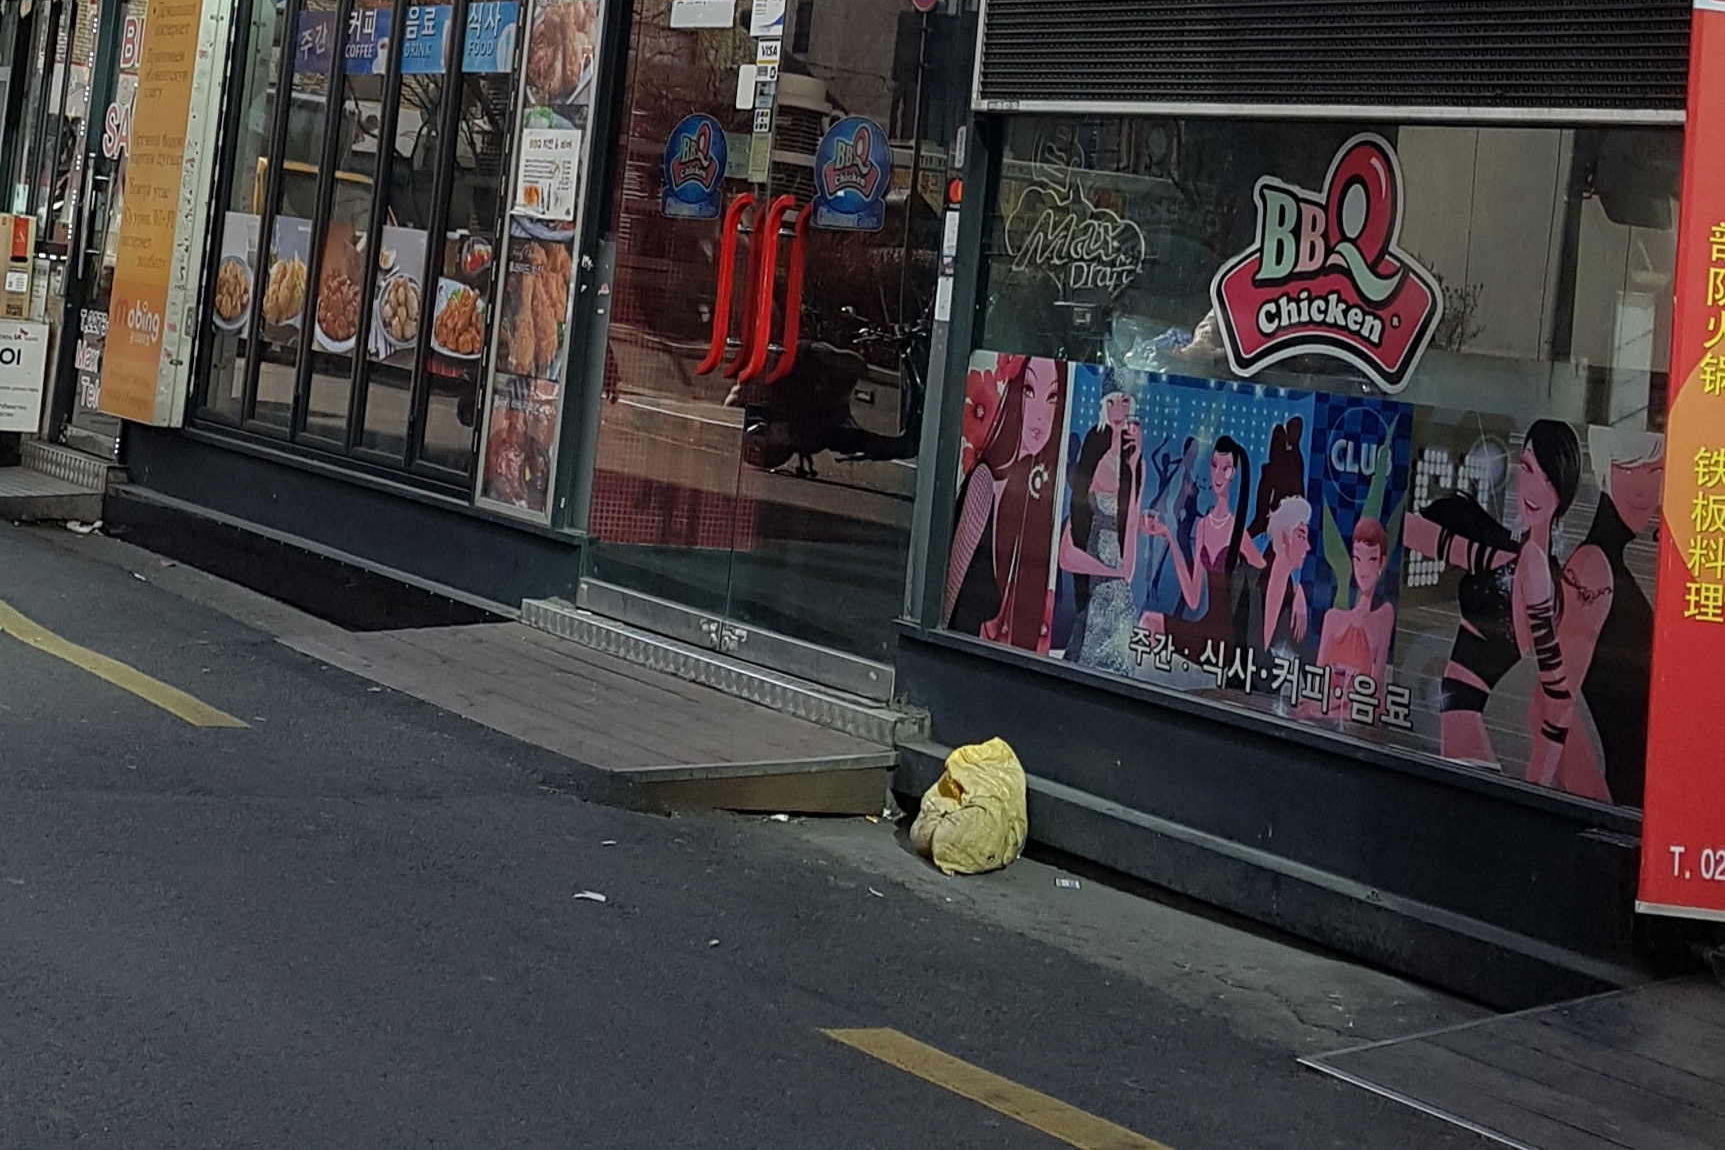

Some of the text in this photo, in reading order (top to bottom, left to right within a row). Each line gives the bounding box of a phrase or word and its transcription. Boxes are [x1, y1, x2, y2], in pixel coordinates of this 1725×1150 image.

[348, 8, 378, 42] 커피
[405, 6, 436, 40] 음료
[468, 2, 502, 38] 식사
[300, 22, 329, 61] 주간
[345, 43, 374, 58] COFFEE
[404, 42, 433, 58] DRINK
[467, 40, 493, 55] FOOD
[761, 45, 778, 57] VISA
[1256, 136, 1410, 300] BBQ
[1257, 290, 1384, 346] Chicken
